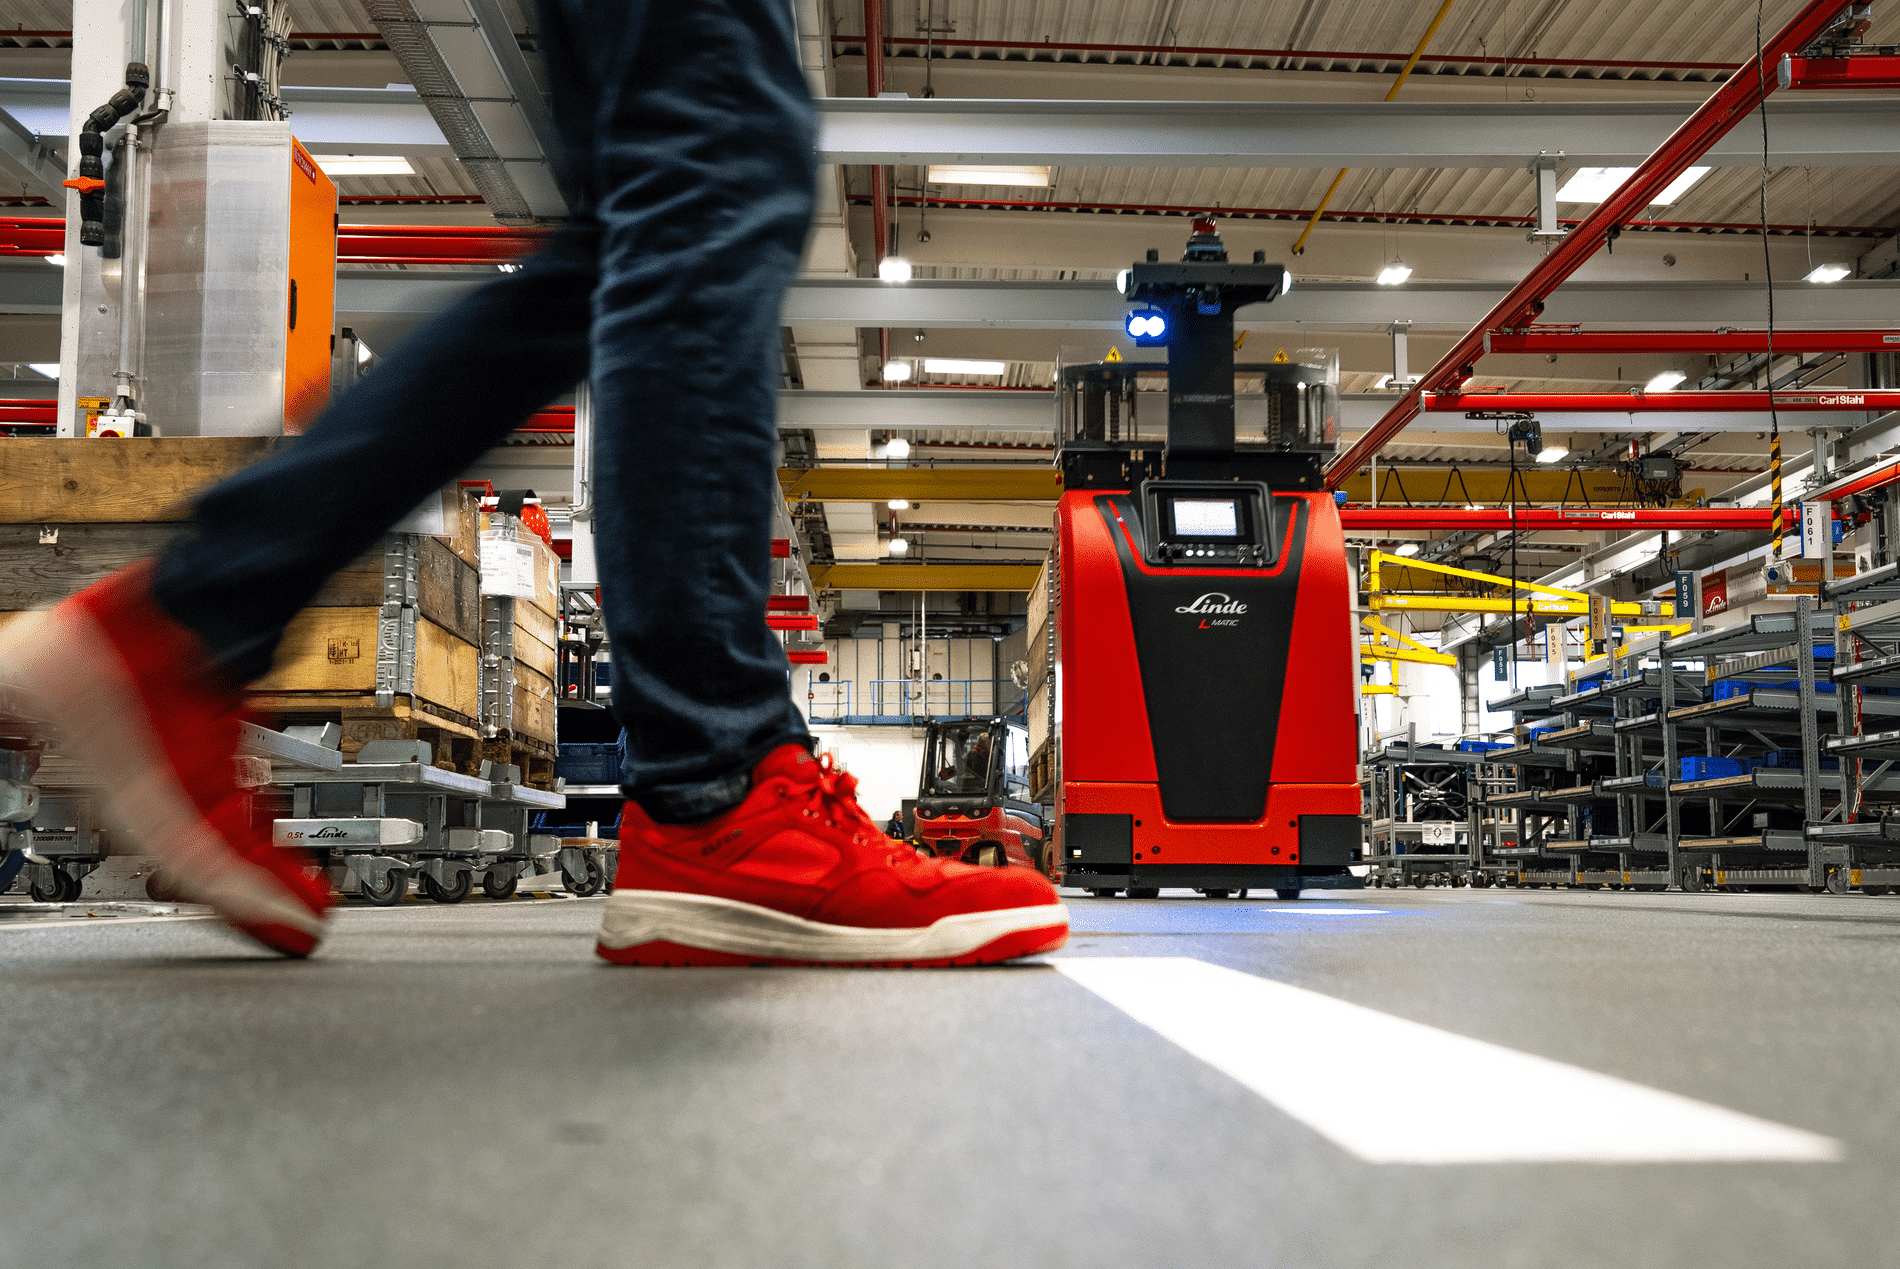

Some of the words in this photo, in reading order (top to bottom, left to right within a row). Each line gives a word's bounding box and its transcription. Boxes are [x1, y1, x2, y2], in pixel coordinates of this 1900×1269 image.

[1806, 507, 1814, 546] F061
[1681, 576, 1689, 608] F059
[1174, 592, 1248, 615] Linde
[1705, 595, 1727, 615] Linde
[1211, 618, 1240, 627] MATIC
[308, 826, 348, 839] Linde
